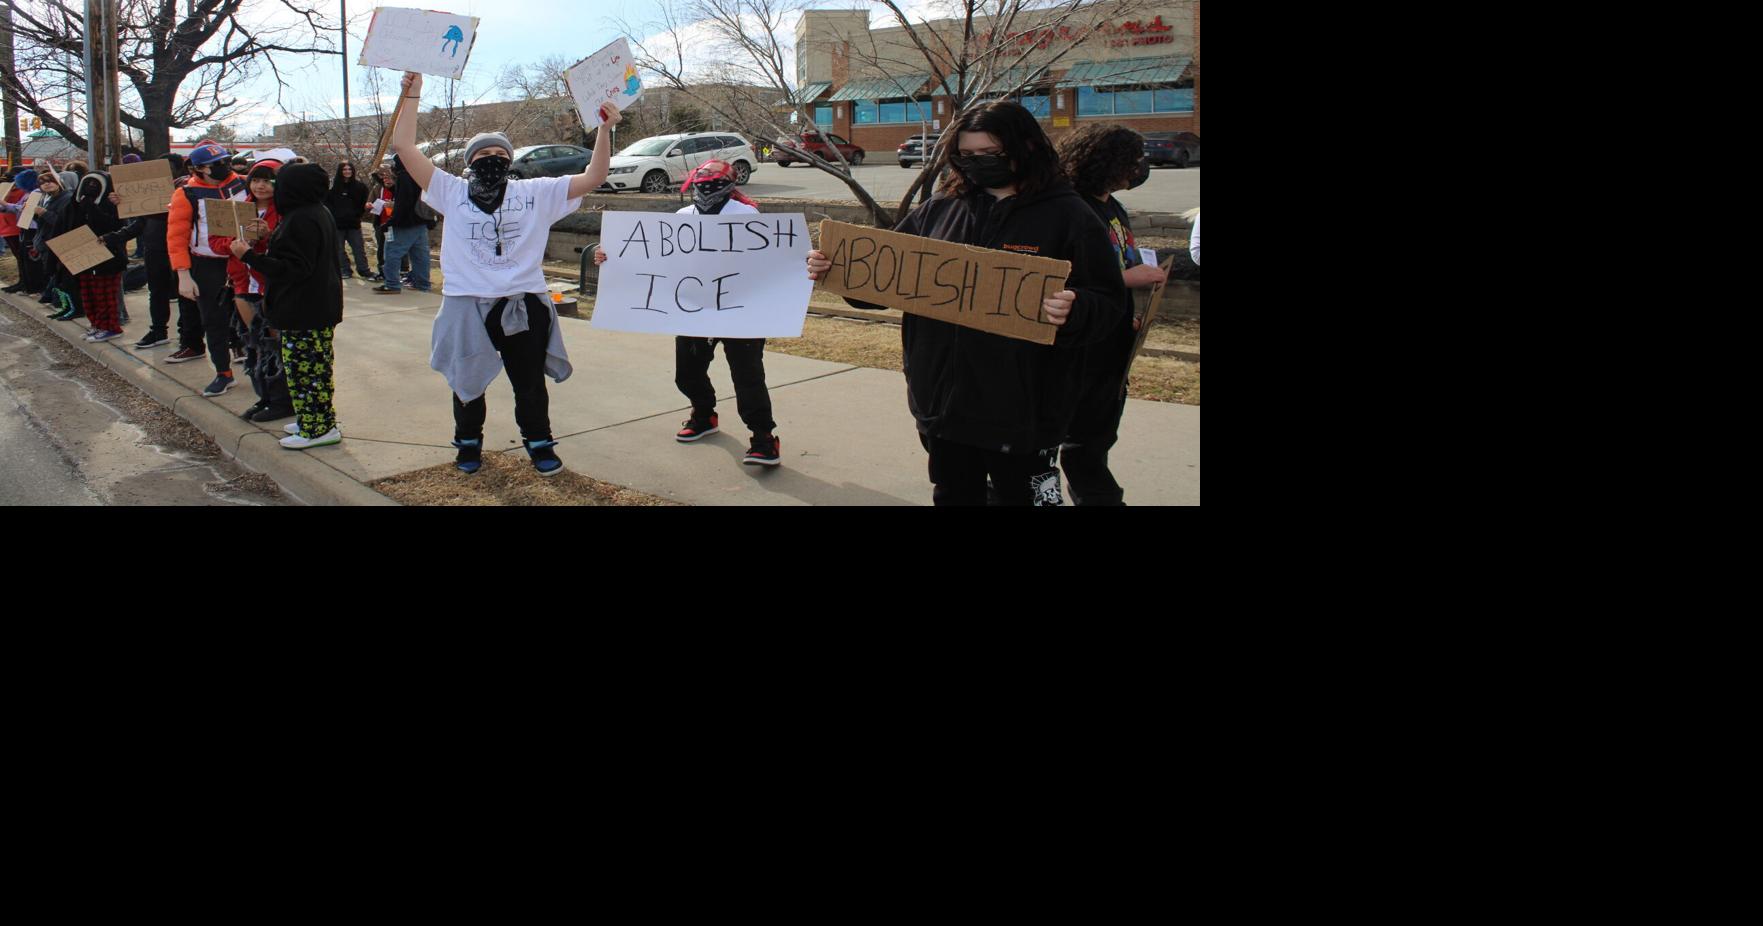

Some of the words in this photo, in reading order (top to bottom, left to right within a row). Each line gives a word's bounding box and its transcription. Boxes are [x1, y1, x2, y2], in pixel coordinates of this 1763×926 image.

[464, 221, 522, 241] ICE
[619, 219, 798, 259] ABOLISH
[630, 272, 745, 315] ICE
[821, 236, 979, 313] ABOLISH
